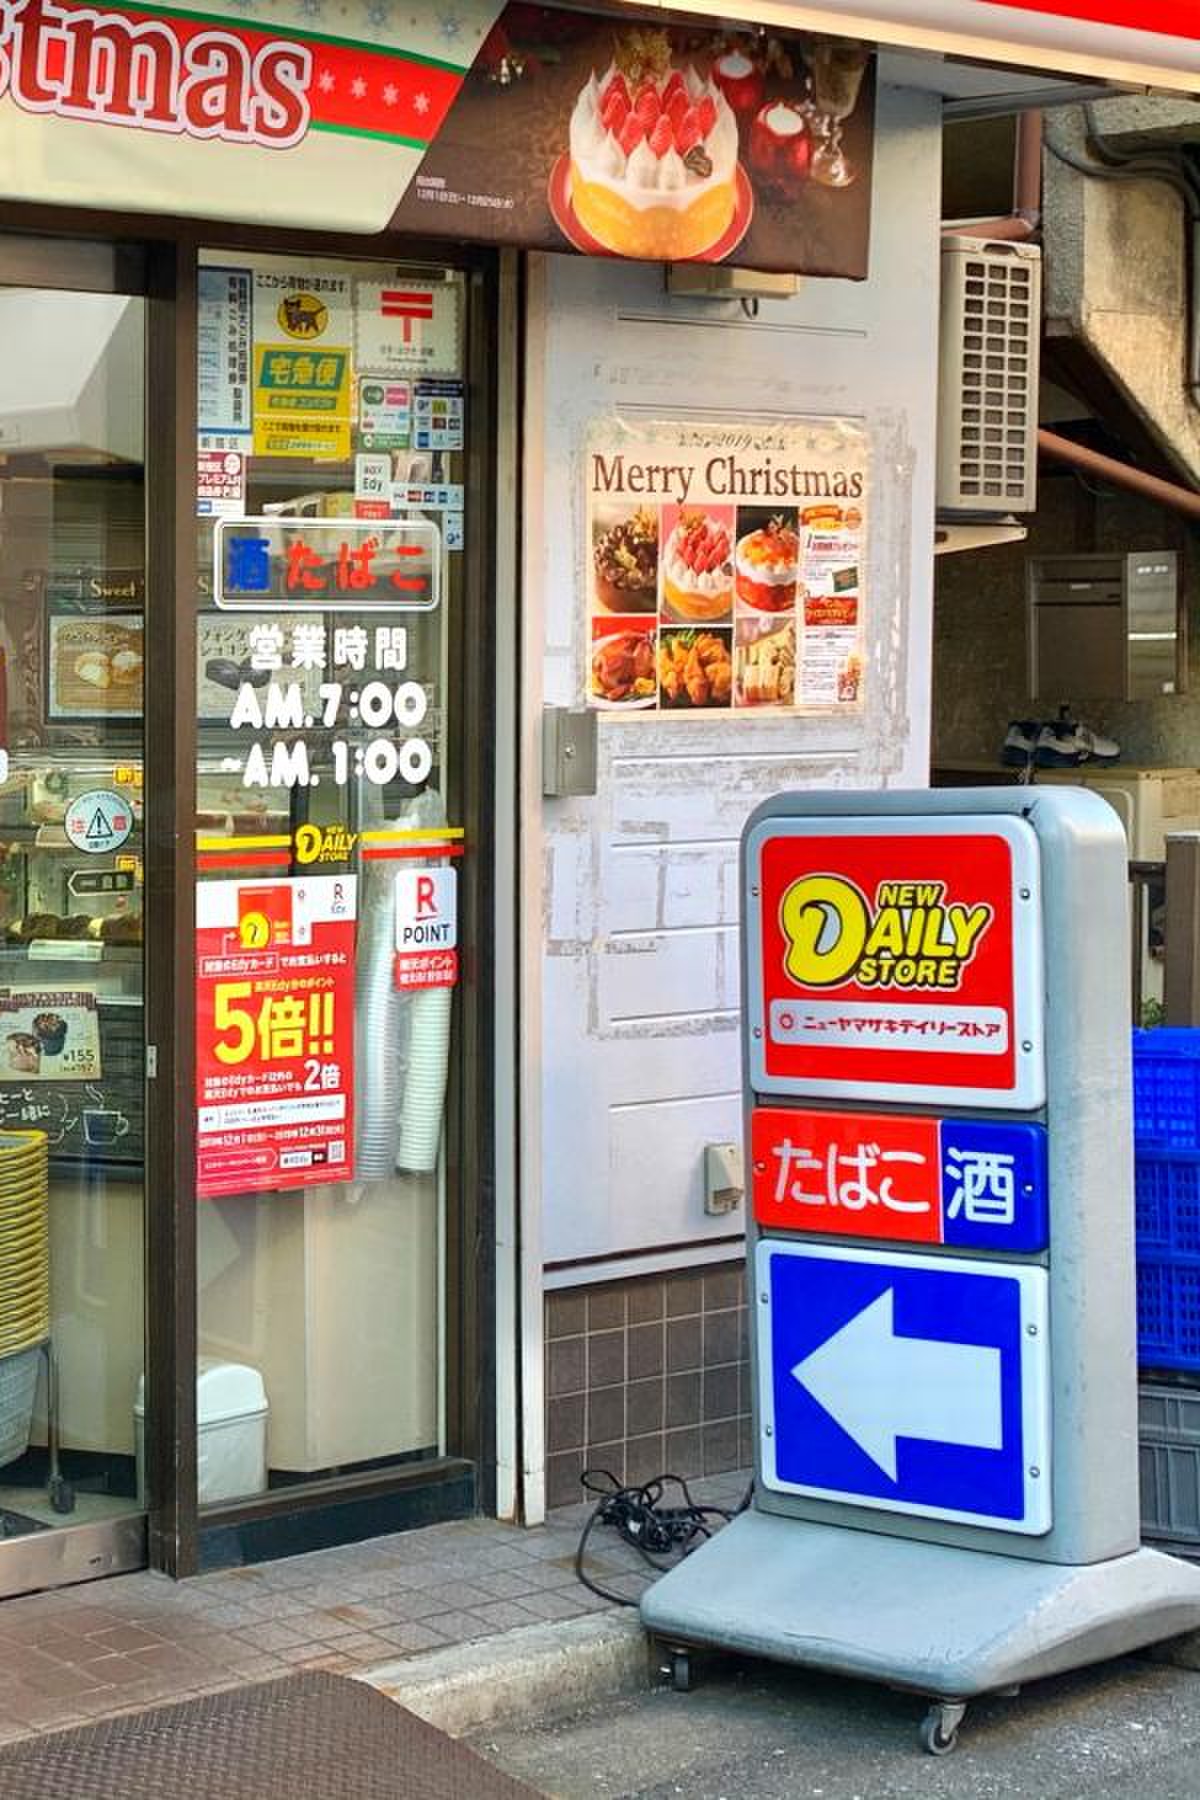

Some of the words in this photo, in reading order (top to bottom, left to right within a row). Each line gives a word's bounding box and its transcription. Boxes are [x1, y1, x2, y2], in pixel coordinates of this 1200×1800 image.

[591, 454, 695, 503] Merry
[705, 456, 864, 499] Christmas
[286, 535, 428, 592] たばこ
[250, 624, 407, 671] 営業時間
[319, 851, 349, 862] STORE
[415, 876, 438, 915] R
[878, 884, 943, 907] NEW
[404, 923, 451, 944] POINT
[781, 874, 990, 986] DAILY
[857, 959, 961, 986] STORE
[802, 1016, 1001, 1038] ニューヤマザキデイリーストア
[303, 1058, 341, 1090] 2倍
[772, 1138, 931, 1213] たばこ
[945, 1147, 1015, 1225] 酒
